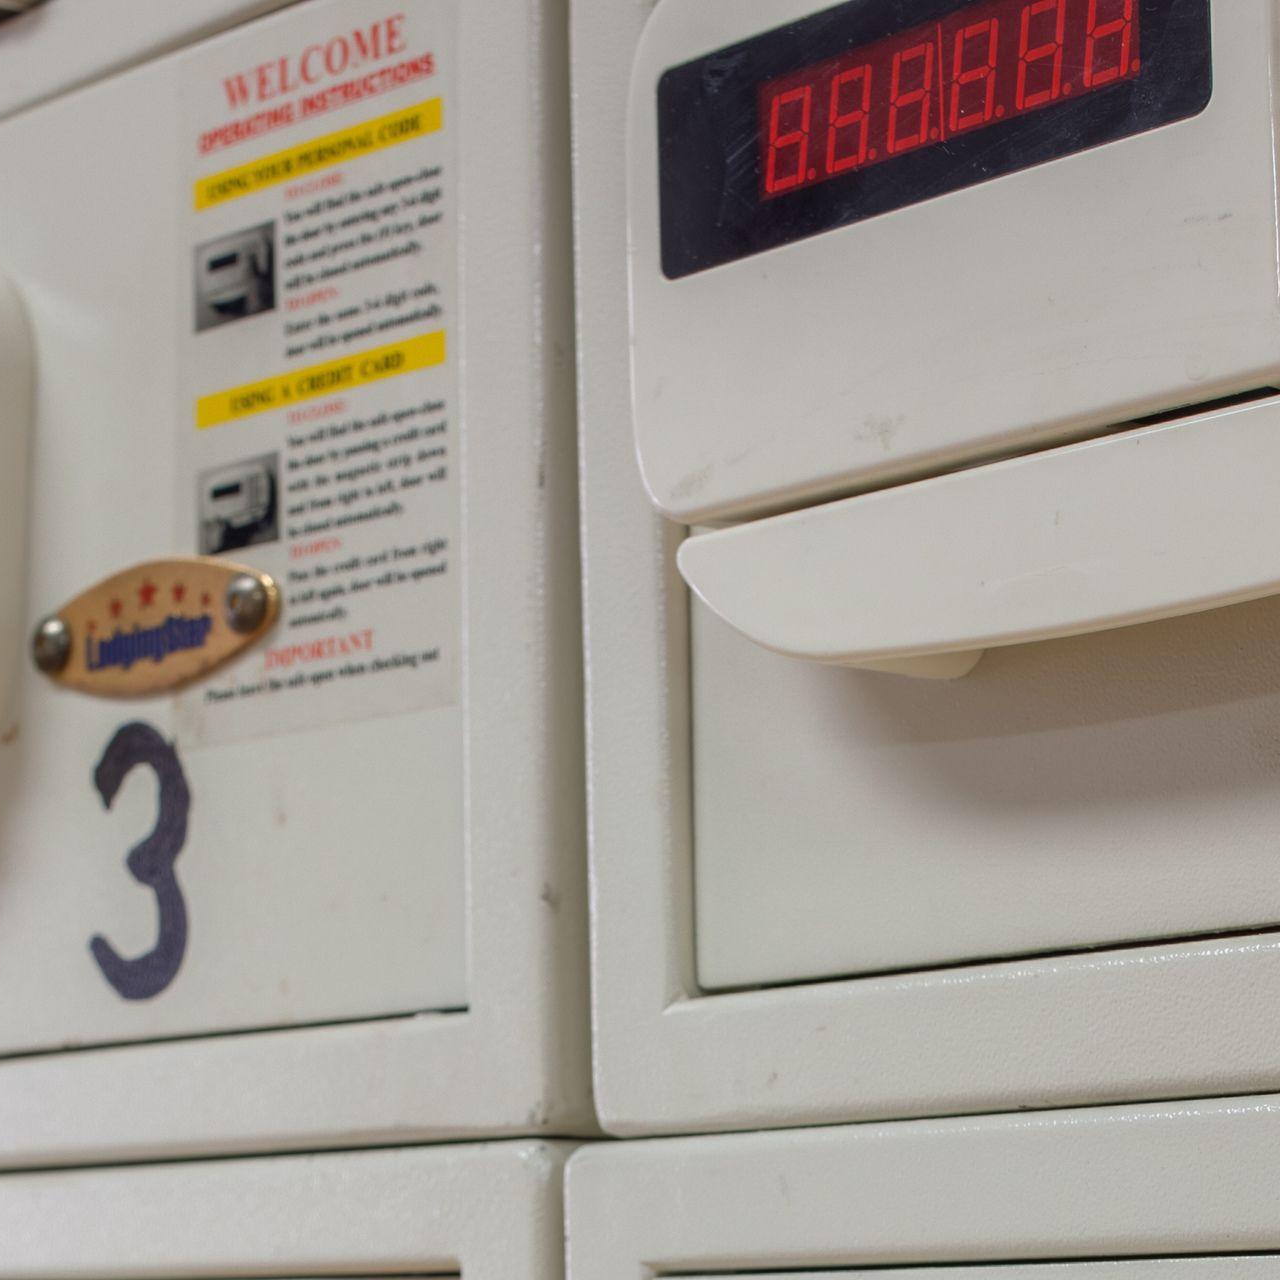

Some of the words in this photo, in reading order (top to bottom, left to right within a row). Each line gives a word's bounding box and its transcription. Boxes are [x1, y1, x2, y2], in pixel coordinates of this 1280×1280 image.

[222, 12, 407, 111] WELCOME
[301, 52, 435, 116] INSTRUCTIONS
[263, 629, 374, 671] IMPORTANT
[89, 721, 192, 1001] 3
